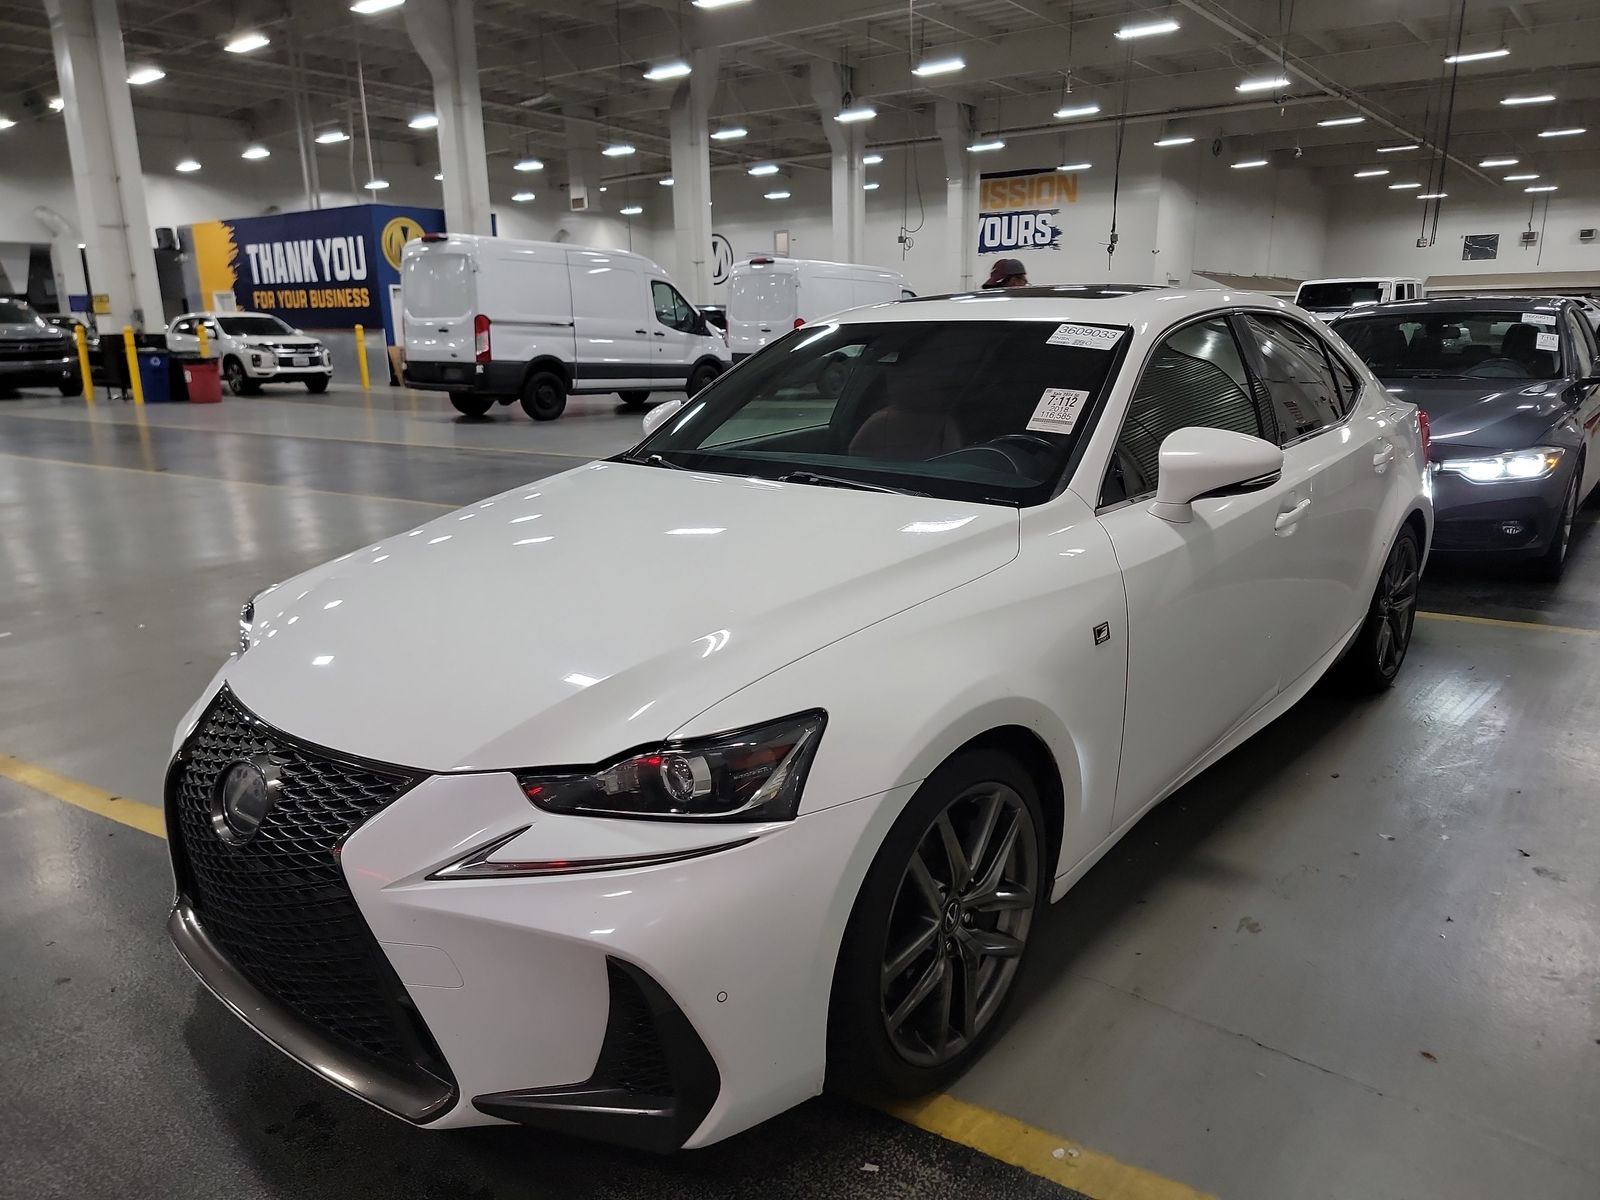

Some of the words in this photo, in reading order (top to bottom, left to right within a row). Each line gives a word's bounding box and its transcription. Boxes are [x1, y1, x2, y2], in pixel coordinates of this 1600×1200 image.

[245, 239, 318, 285] THANK
[315, 235, 367, 282] YOU
[253, 290, 276, 309] FOR
[278, 289, 308, 309] YOUR
[309, 287, 370, 309] BUSINESS
[1059, 326, 1117, 339] 3609033
[1047, 395, 1078, 407] 7:112
